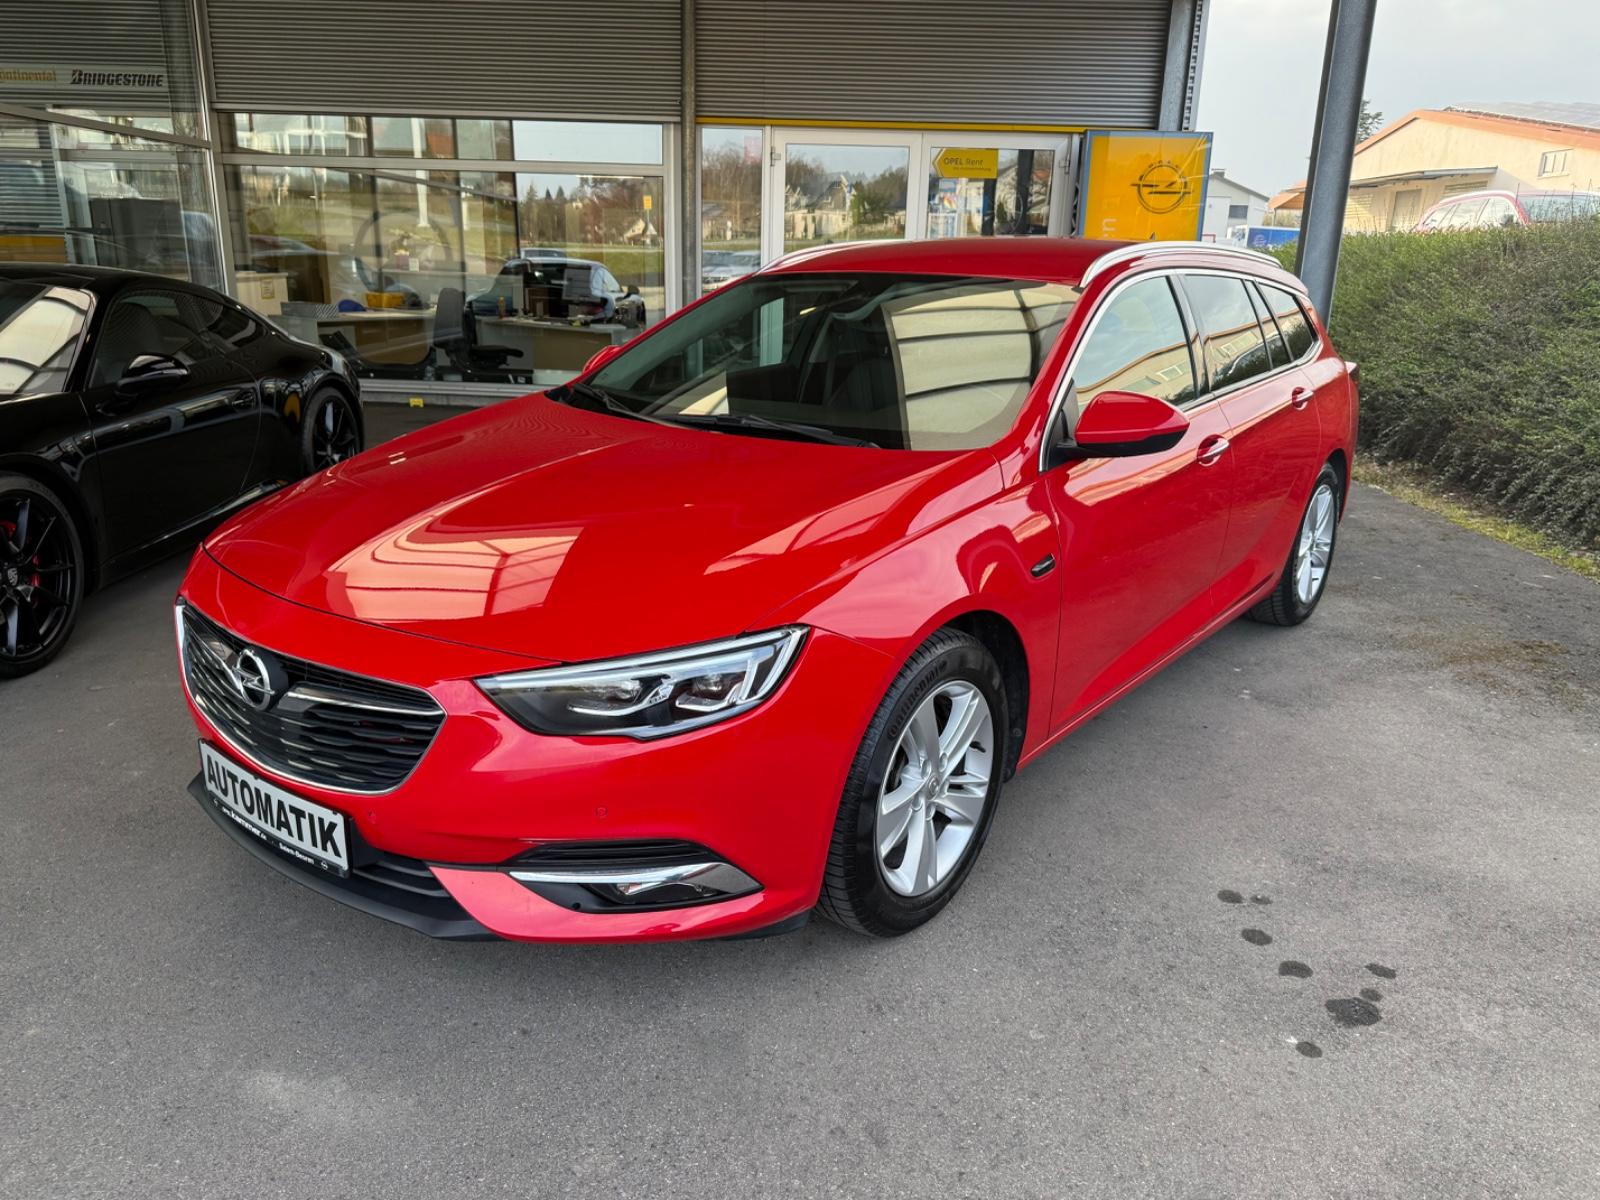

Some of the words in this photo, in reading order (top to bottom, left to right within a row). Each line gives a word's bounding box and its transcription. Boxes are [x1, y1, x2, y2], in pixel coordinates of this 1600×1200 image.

[0, 69, 57, 81] ontinental
[70, 69, 164, 87] BRIDGESTONE
[944, 157, 963, 165] OPEL
[966, 158, 984, 167] Rent
[206, 754, 342, 859] AUTOMATIK
